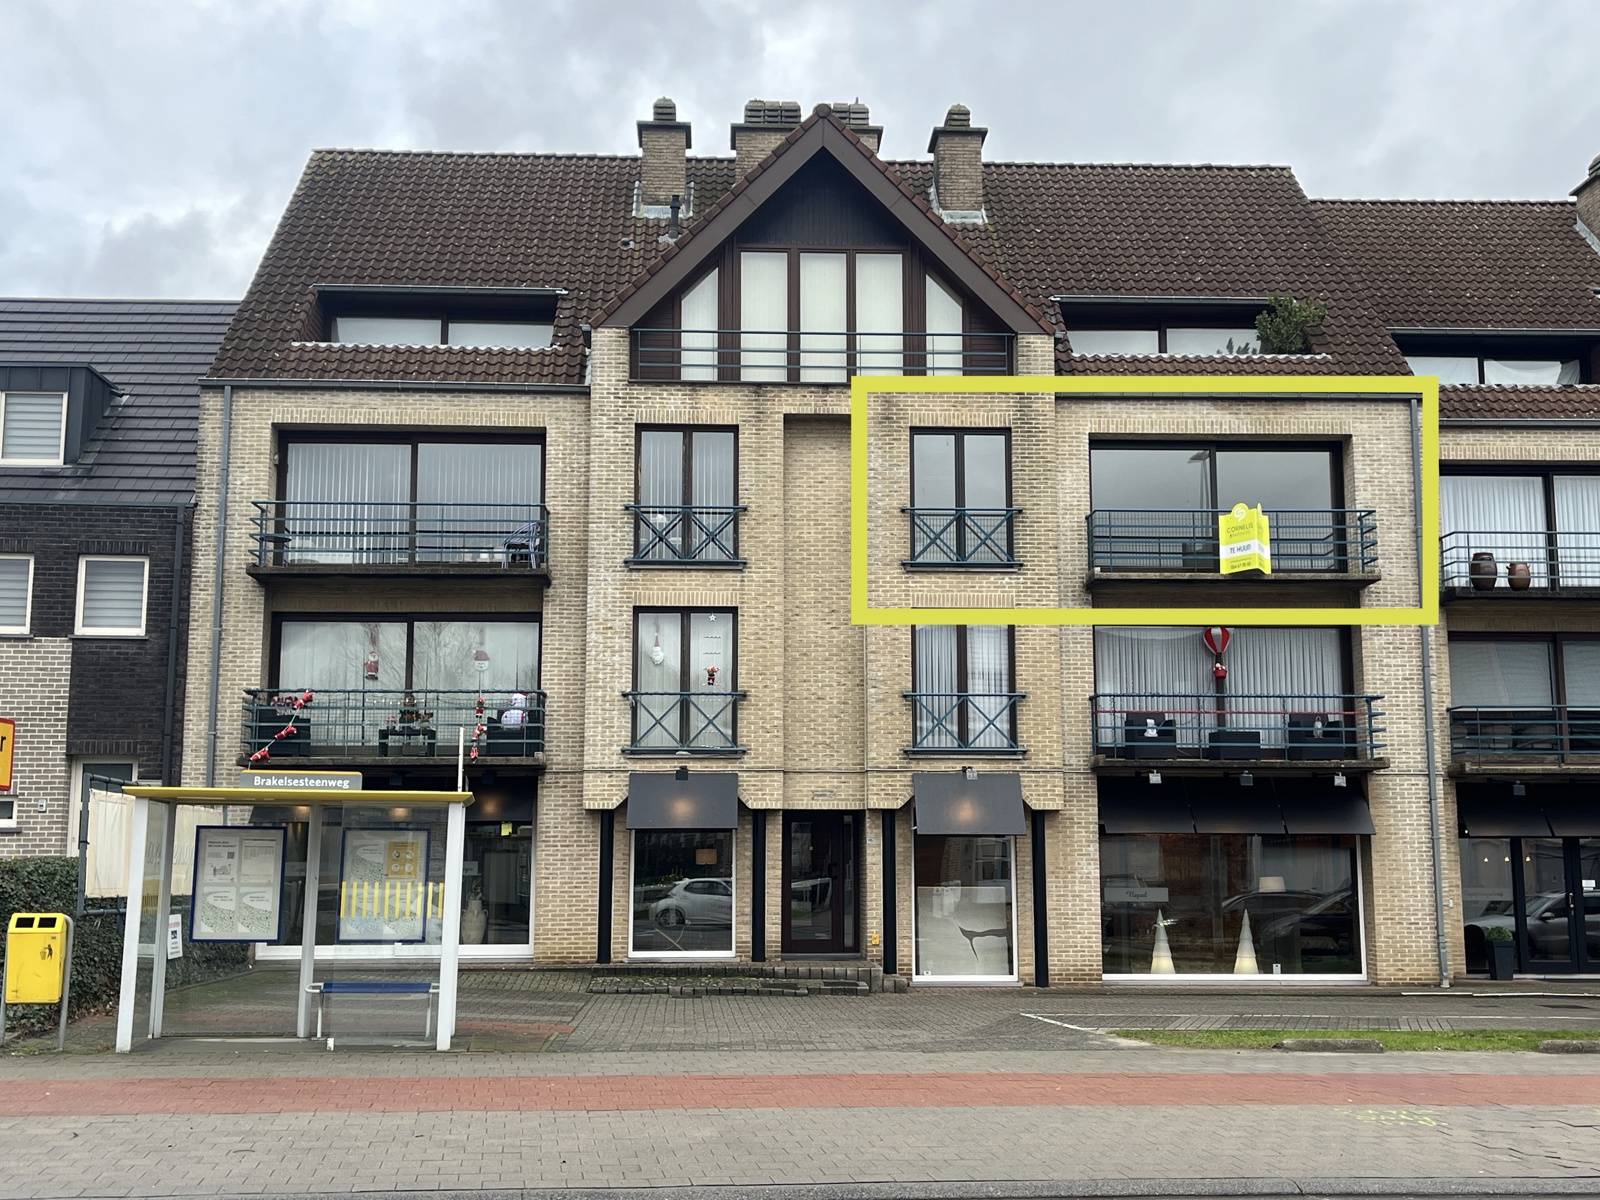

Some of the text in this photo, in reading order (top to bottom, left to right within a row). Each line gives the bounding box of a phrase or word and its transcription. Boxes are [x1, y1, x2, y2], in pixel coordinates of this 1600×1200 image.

[1227, 523, 1253, 533] CORNELIS
[1237, 544, 1251, 552] HUUR
[253, 776, 350, 789] Brakelsesteenweg
[1125, 890, 1148, 900] Nepal
